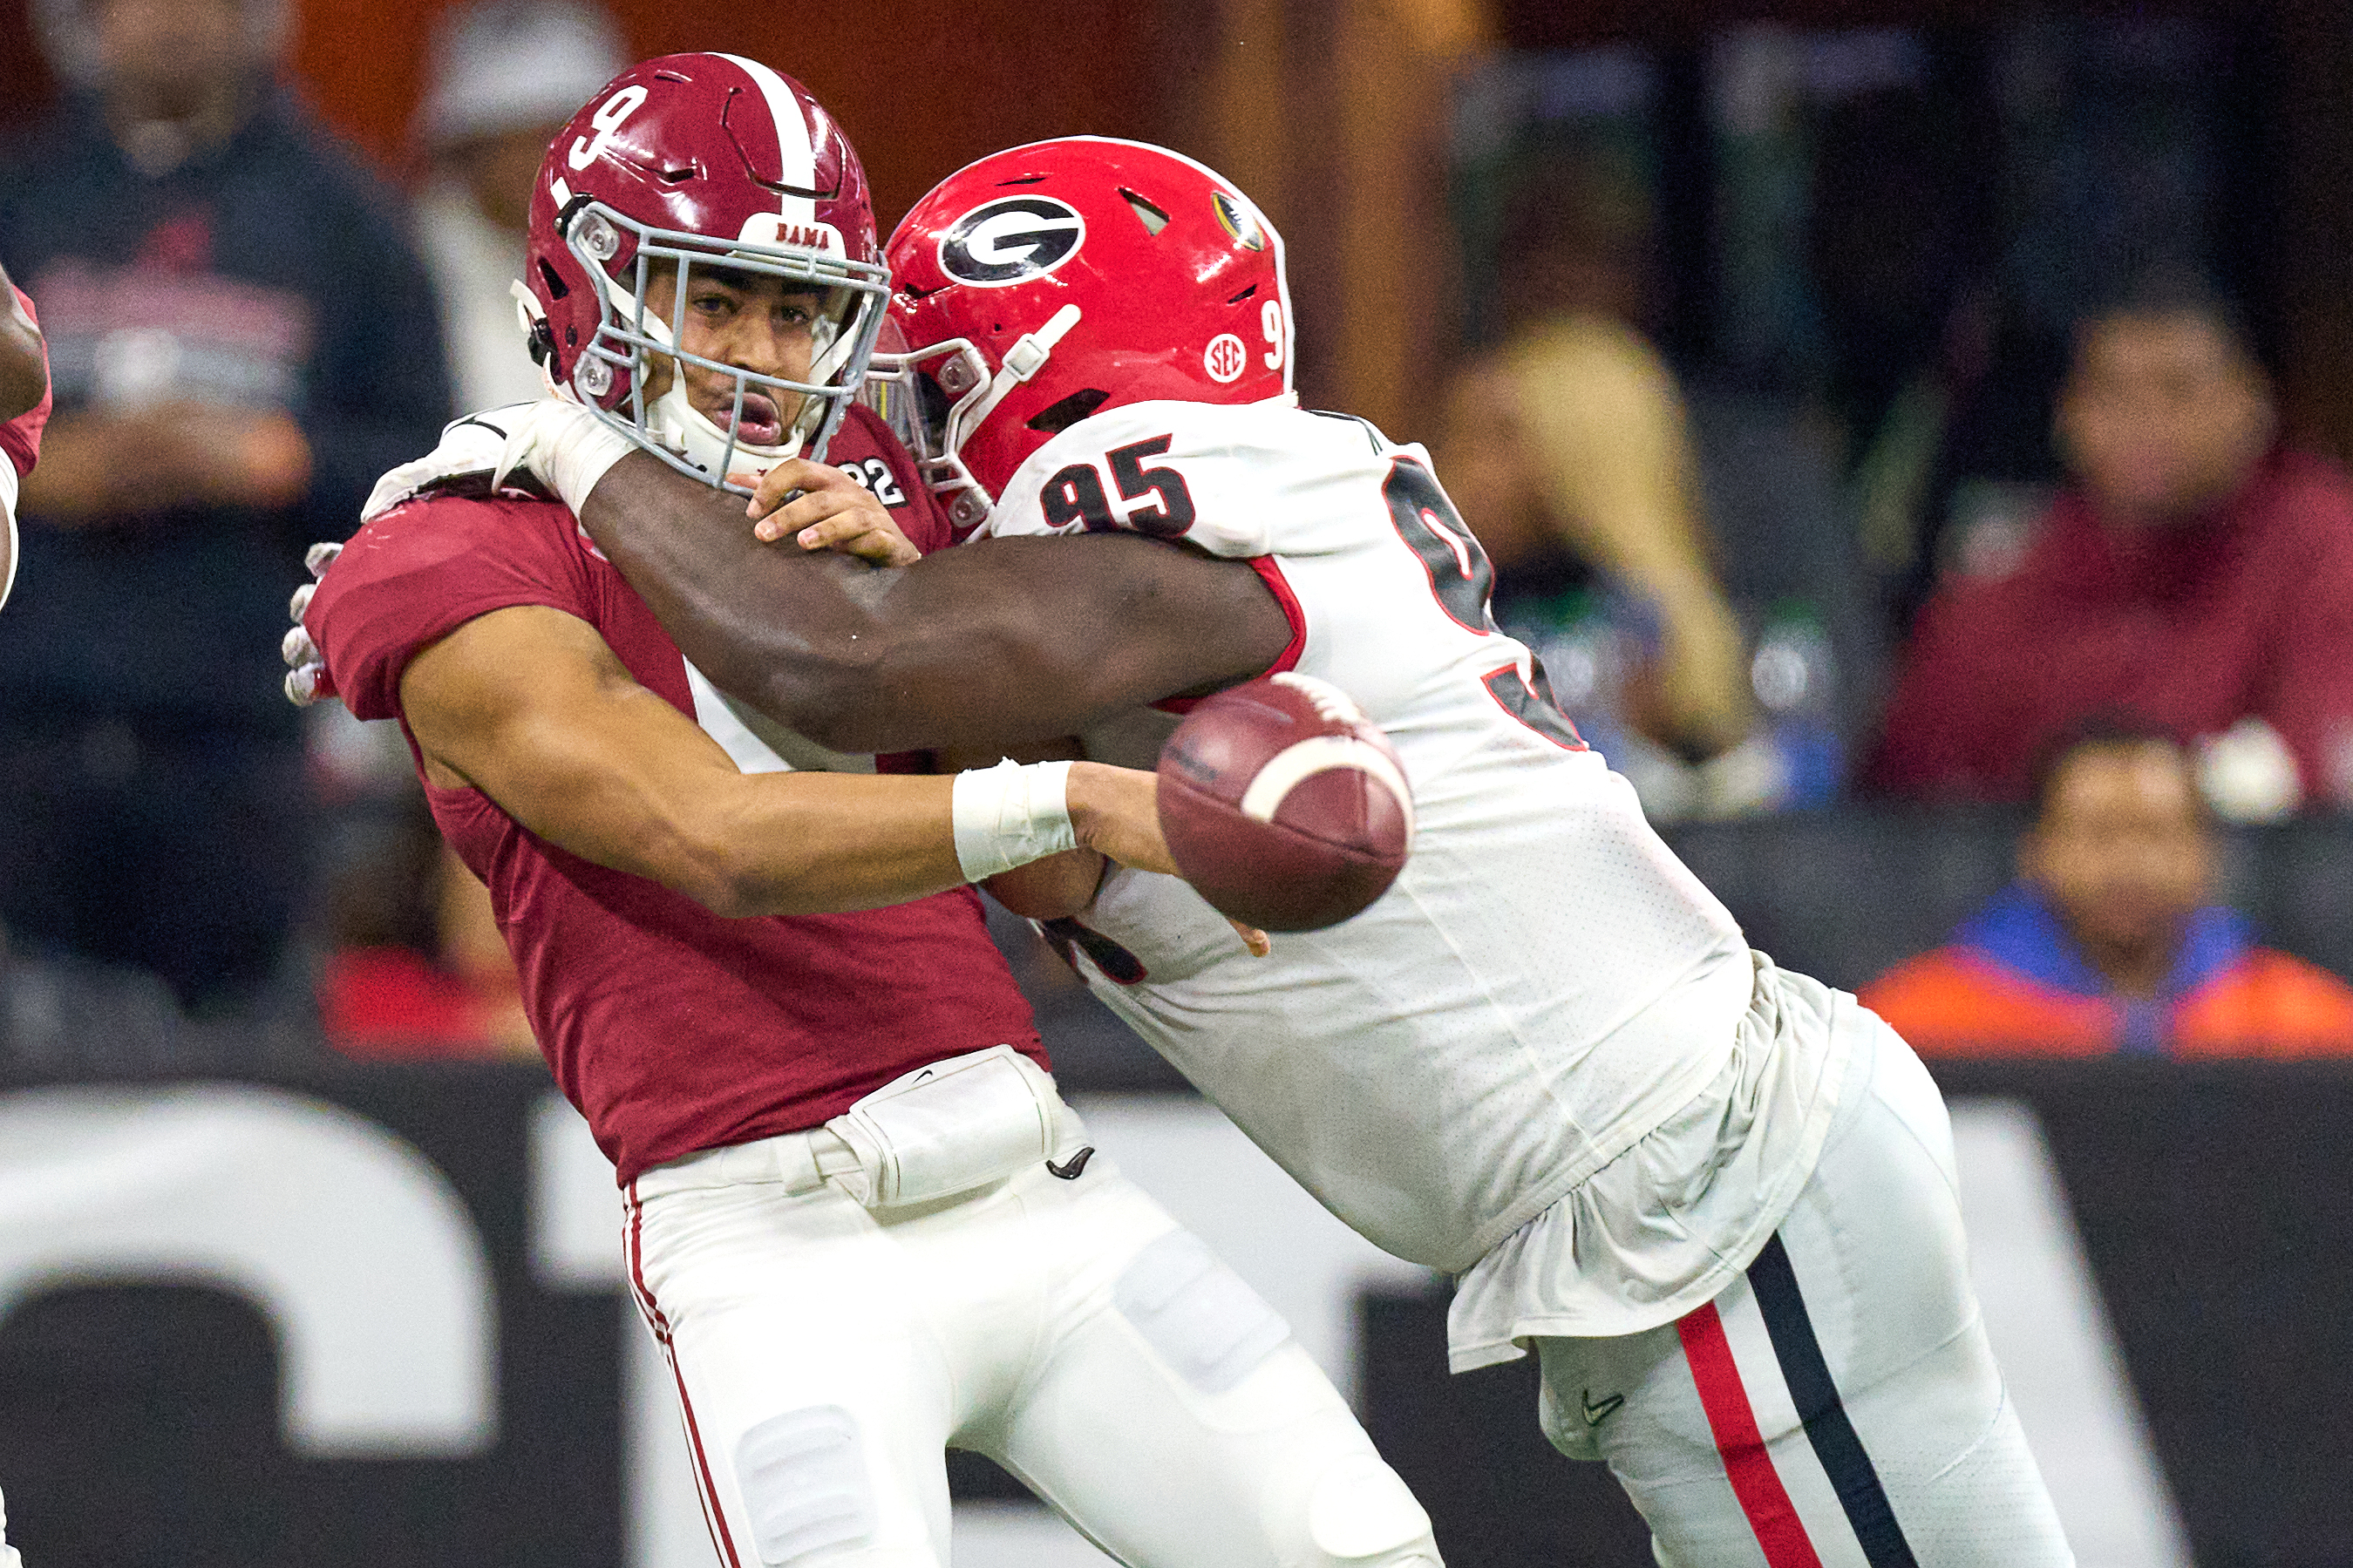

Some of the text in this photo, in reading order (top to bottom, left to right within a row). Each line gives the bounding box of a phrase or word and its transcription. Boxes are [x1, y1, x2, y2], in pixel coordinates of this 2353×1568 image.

[568, 85, 648, 170] 9
[775, 222, 829, 251] BAMA
[1210, 339, 1241, 377] SEC
[1261, 300, 1284, 370] 9
[1040, 433, 1195, 537] 95
